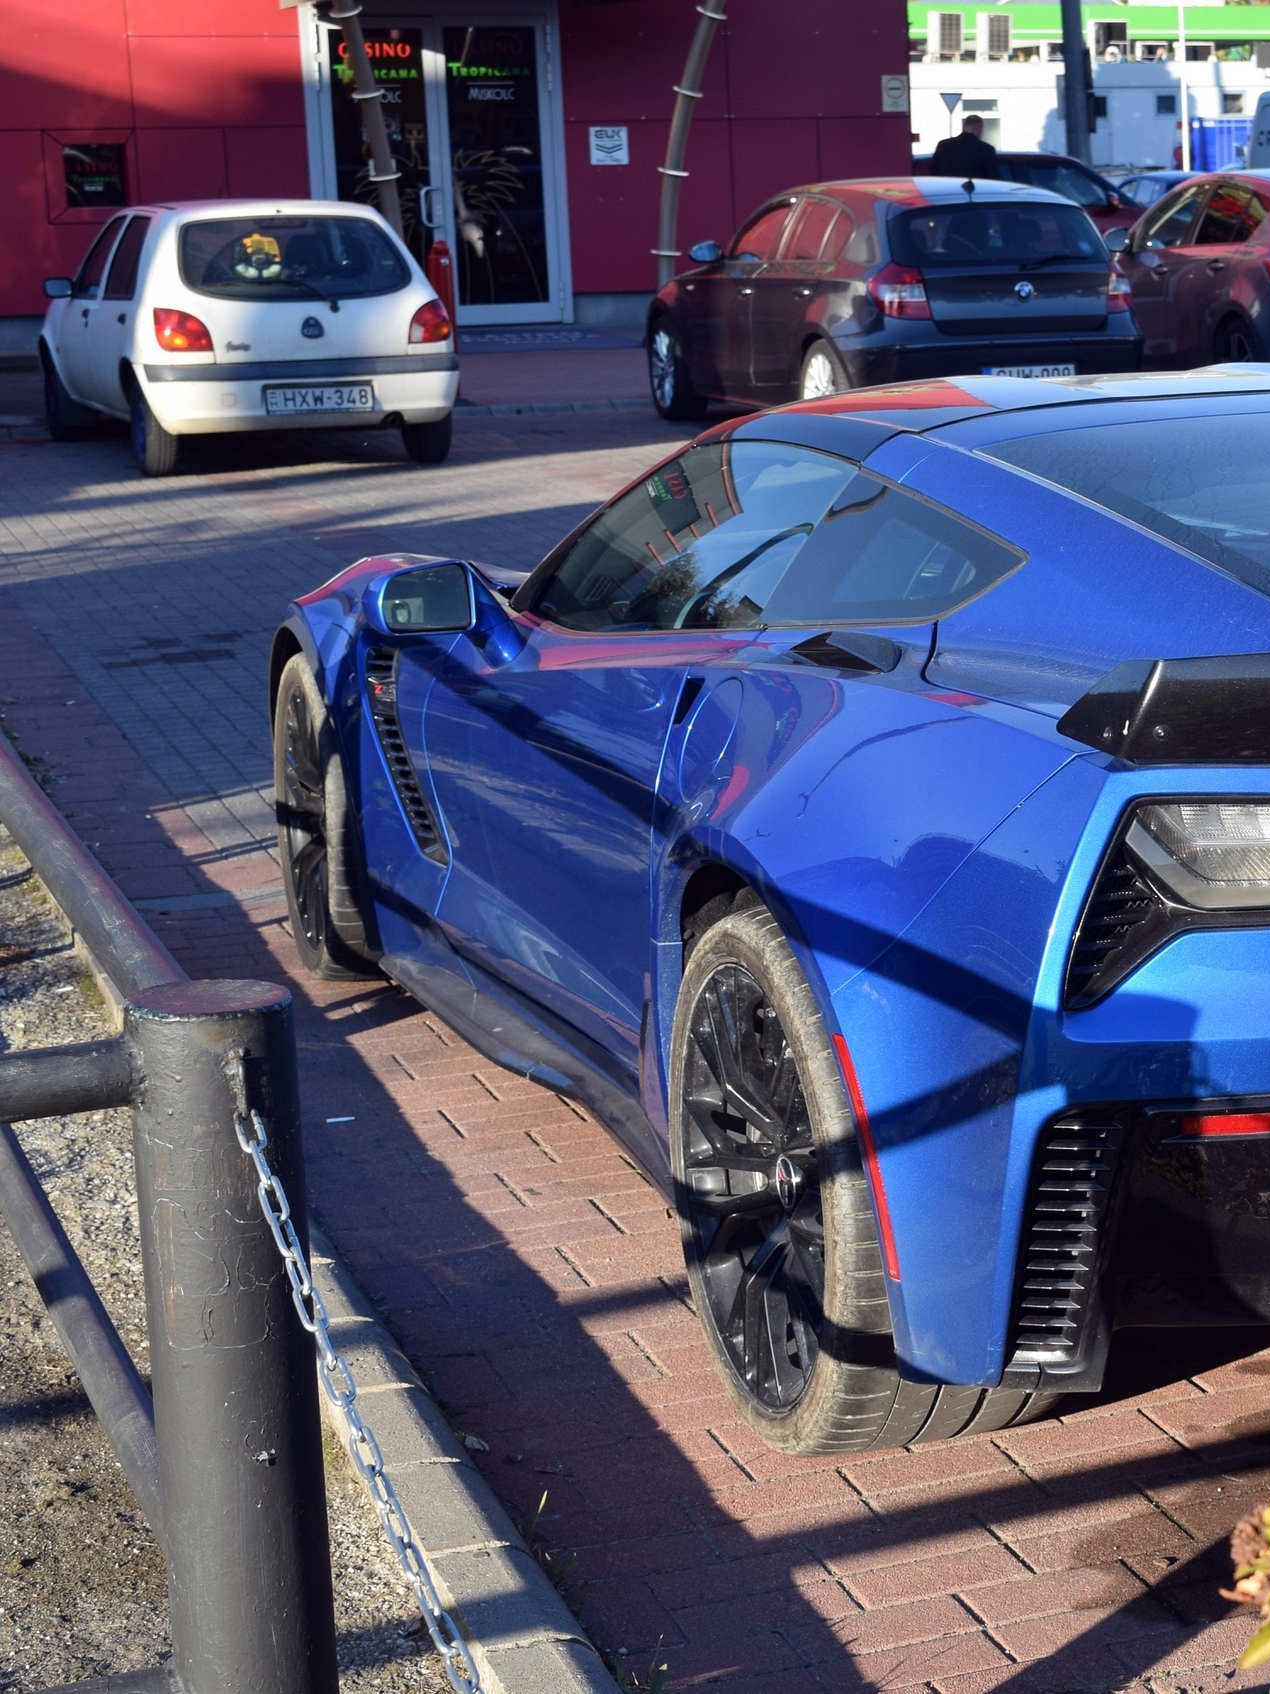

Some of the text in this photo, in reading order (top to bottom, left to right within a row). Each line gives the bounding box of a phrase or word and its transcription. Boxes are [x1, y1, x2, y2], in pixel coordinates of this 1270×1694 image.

[337, 42, 412, 58] CSINO
[333, 64, 419, 80] TRICANA
[283, 388, 369, 408] HXW-348
